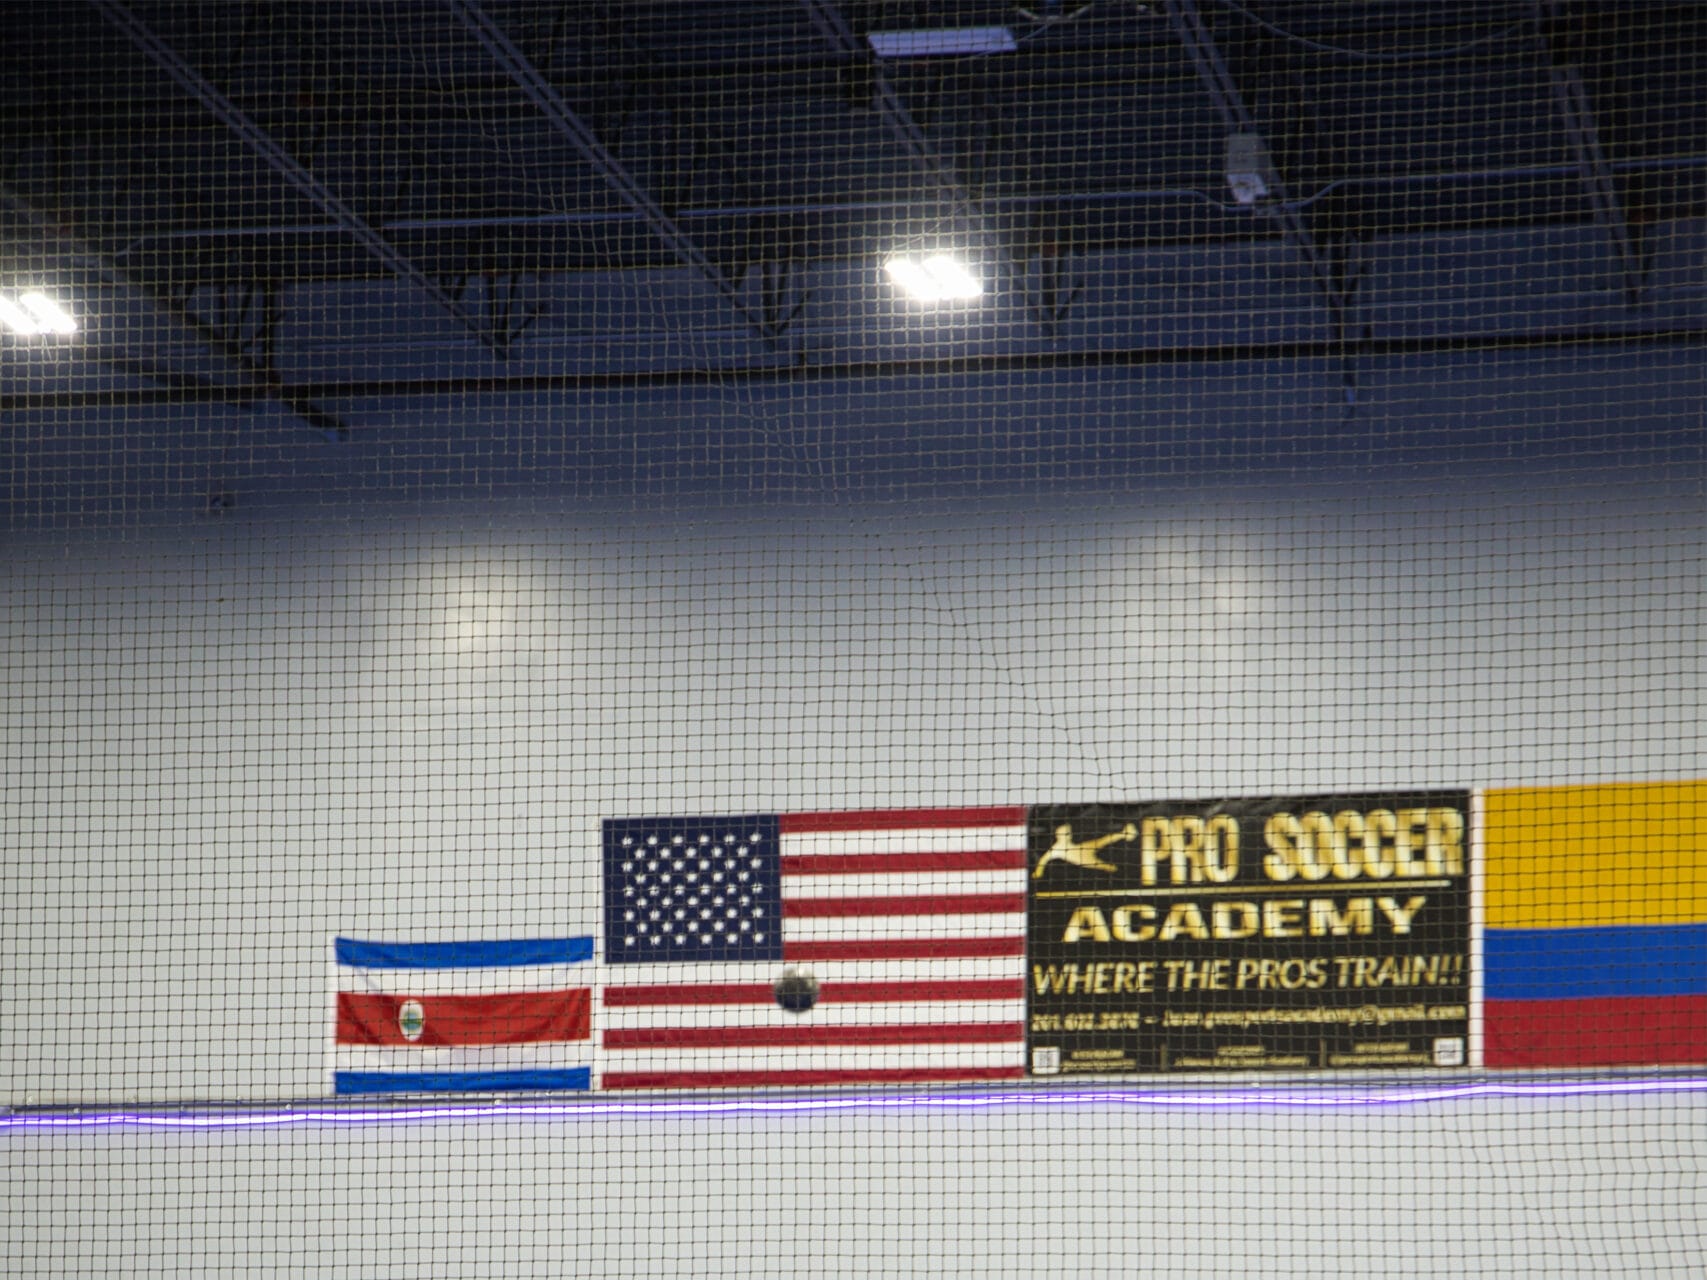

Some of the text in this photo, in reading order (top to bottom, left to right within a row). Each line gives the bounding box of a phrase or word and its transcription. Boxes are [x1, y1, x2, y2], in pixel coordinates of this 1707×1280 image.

[1141, 806, 1465, 886] PRO SOCCER
[1061, 896, 1427, 943] ACADEMY
[1032, 953, 1465, 996] WHERE THE PROS TRAIN!!
